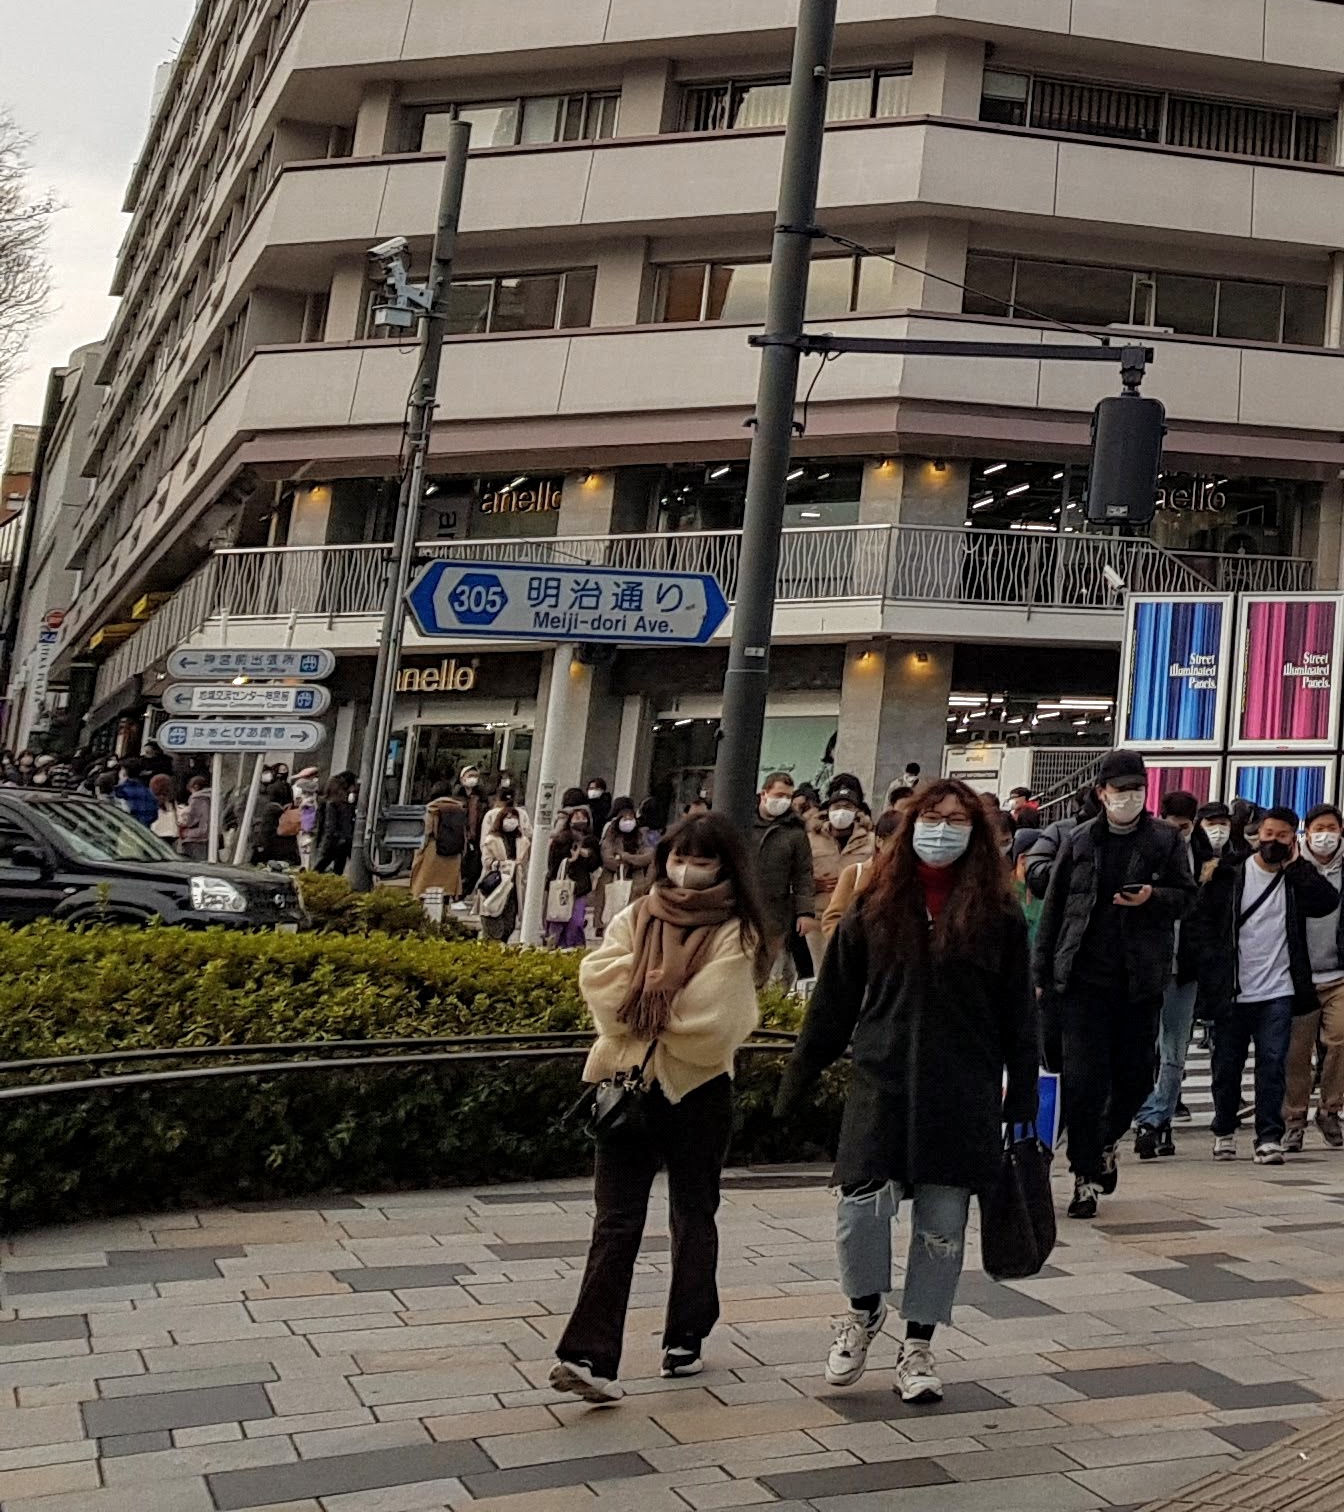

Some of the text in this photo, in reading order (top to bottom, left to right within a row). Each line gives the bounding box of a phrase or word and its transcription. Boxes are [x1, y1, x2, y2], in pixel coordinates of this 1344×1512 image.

[452, 584, 502, 614] 305
[526, 576, 684, 613] 明治通り
[532, 611, 675, 635] Meiji-dori Ave.
[1190, 652, 1215, 665] Street
[1303, 651, 1329, 664] Street
[396, 658, 475, 692] nello
